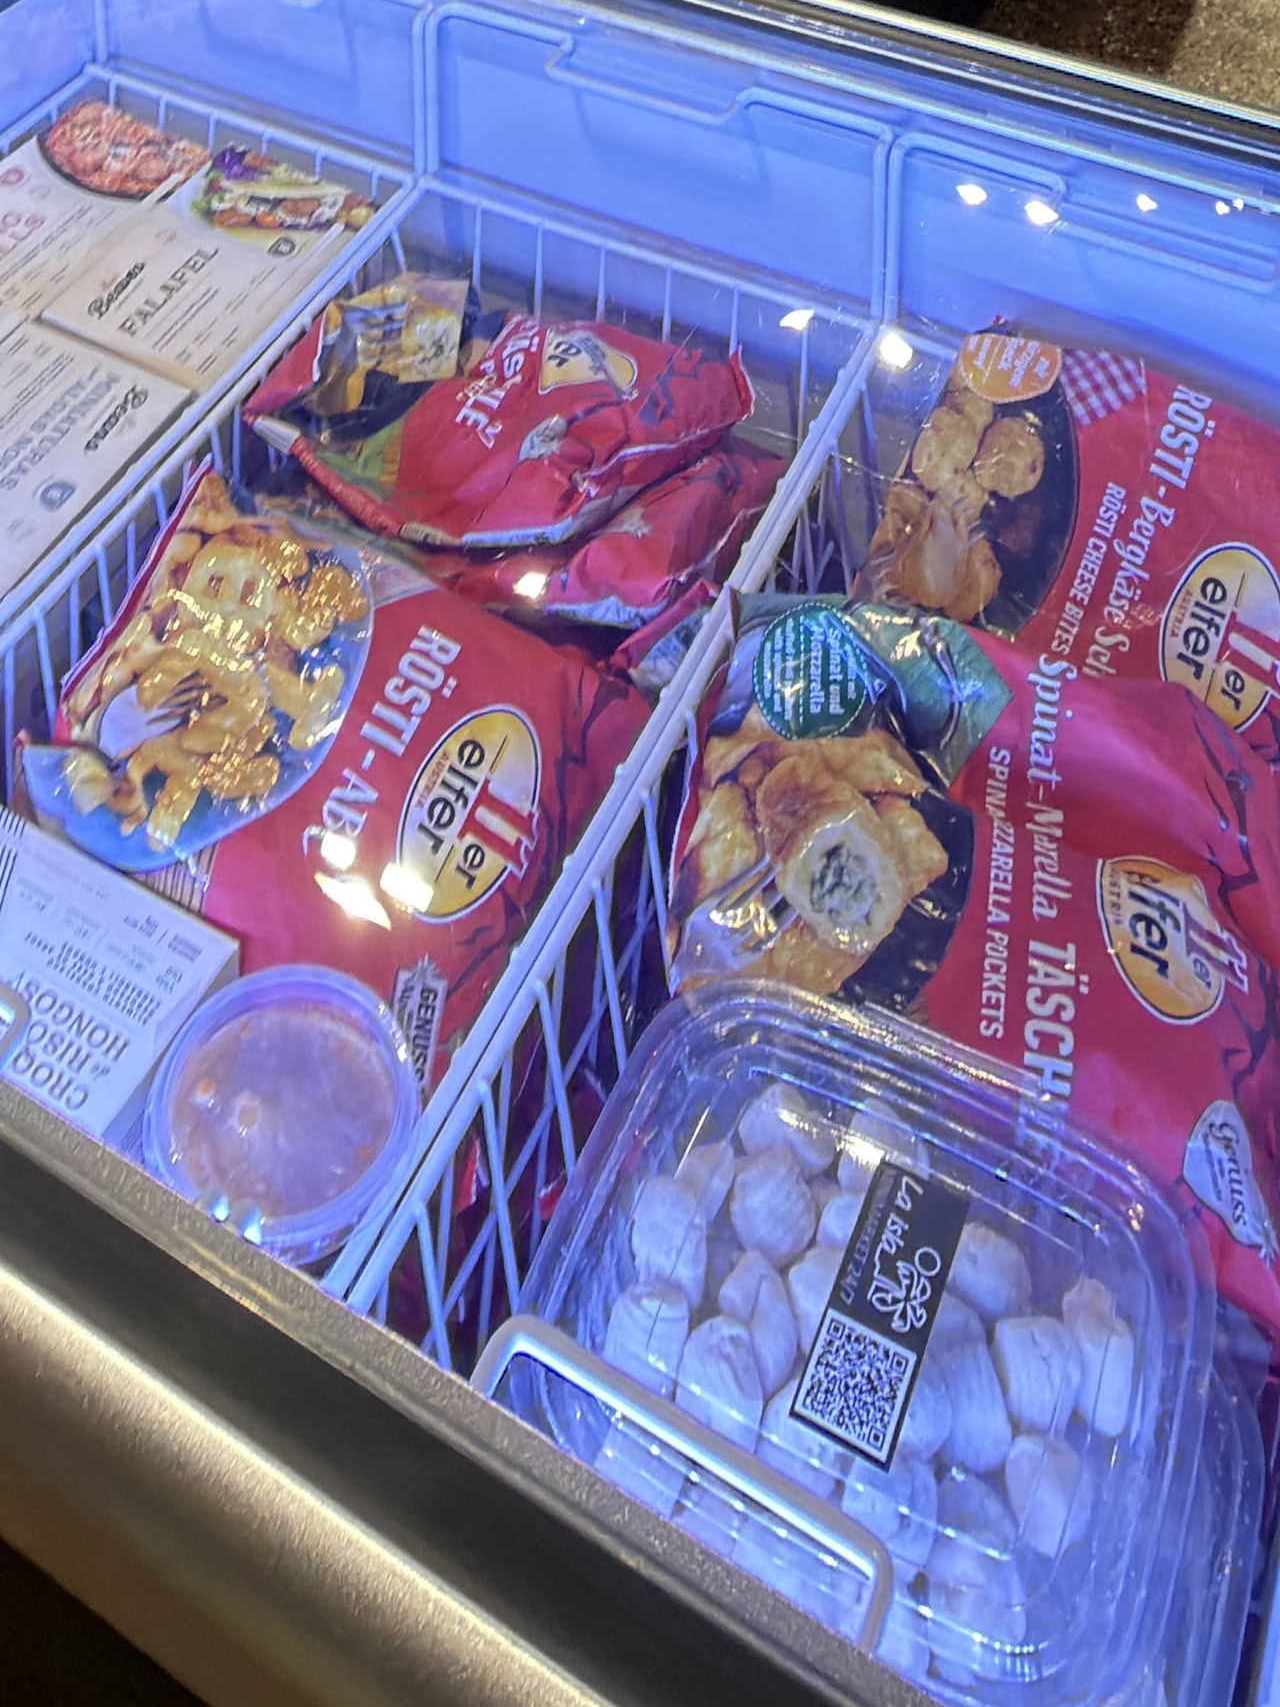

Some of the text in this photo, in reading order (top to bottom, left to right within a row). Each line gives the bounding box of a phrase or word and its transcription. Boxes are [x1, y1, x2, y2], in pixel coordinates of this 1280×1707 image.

[88, 260, 146, 319] Beans
[120, 246, 220, 338] FALAFEL
[79, 384, 152, 457] Beans
[1046, 483, 1127, 662] RÖSTI CHEESE BITES
[829, 627, 843, 681] Spinat
[1177, 577, 1227, 682] elfer
[413, 750, 451, 809] AUSTRIA
[417, 738, 486, 856] elfer
[980, 928, 1009, 1040] POCKETS
[883, 1175, 924, 1256] La isla
